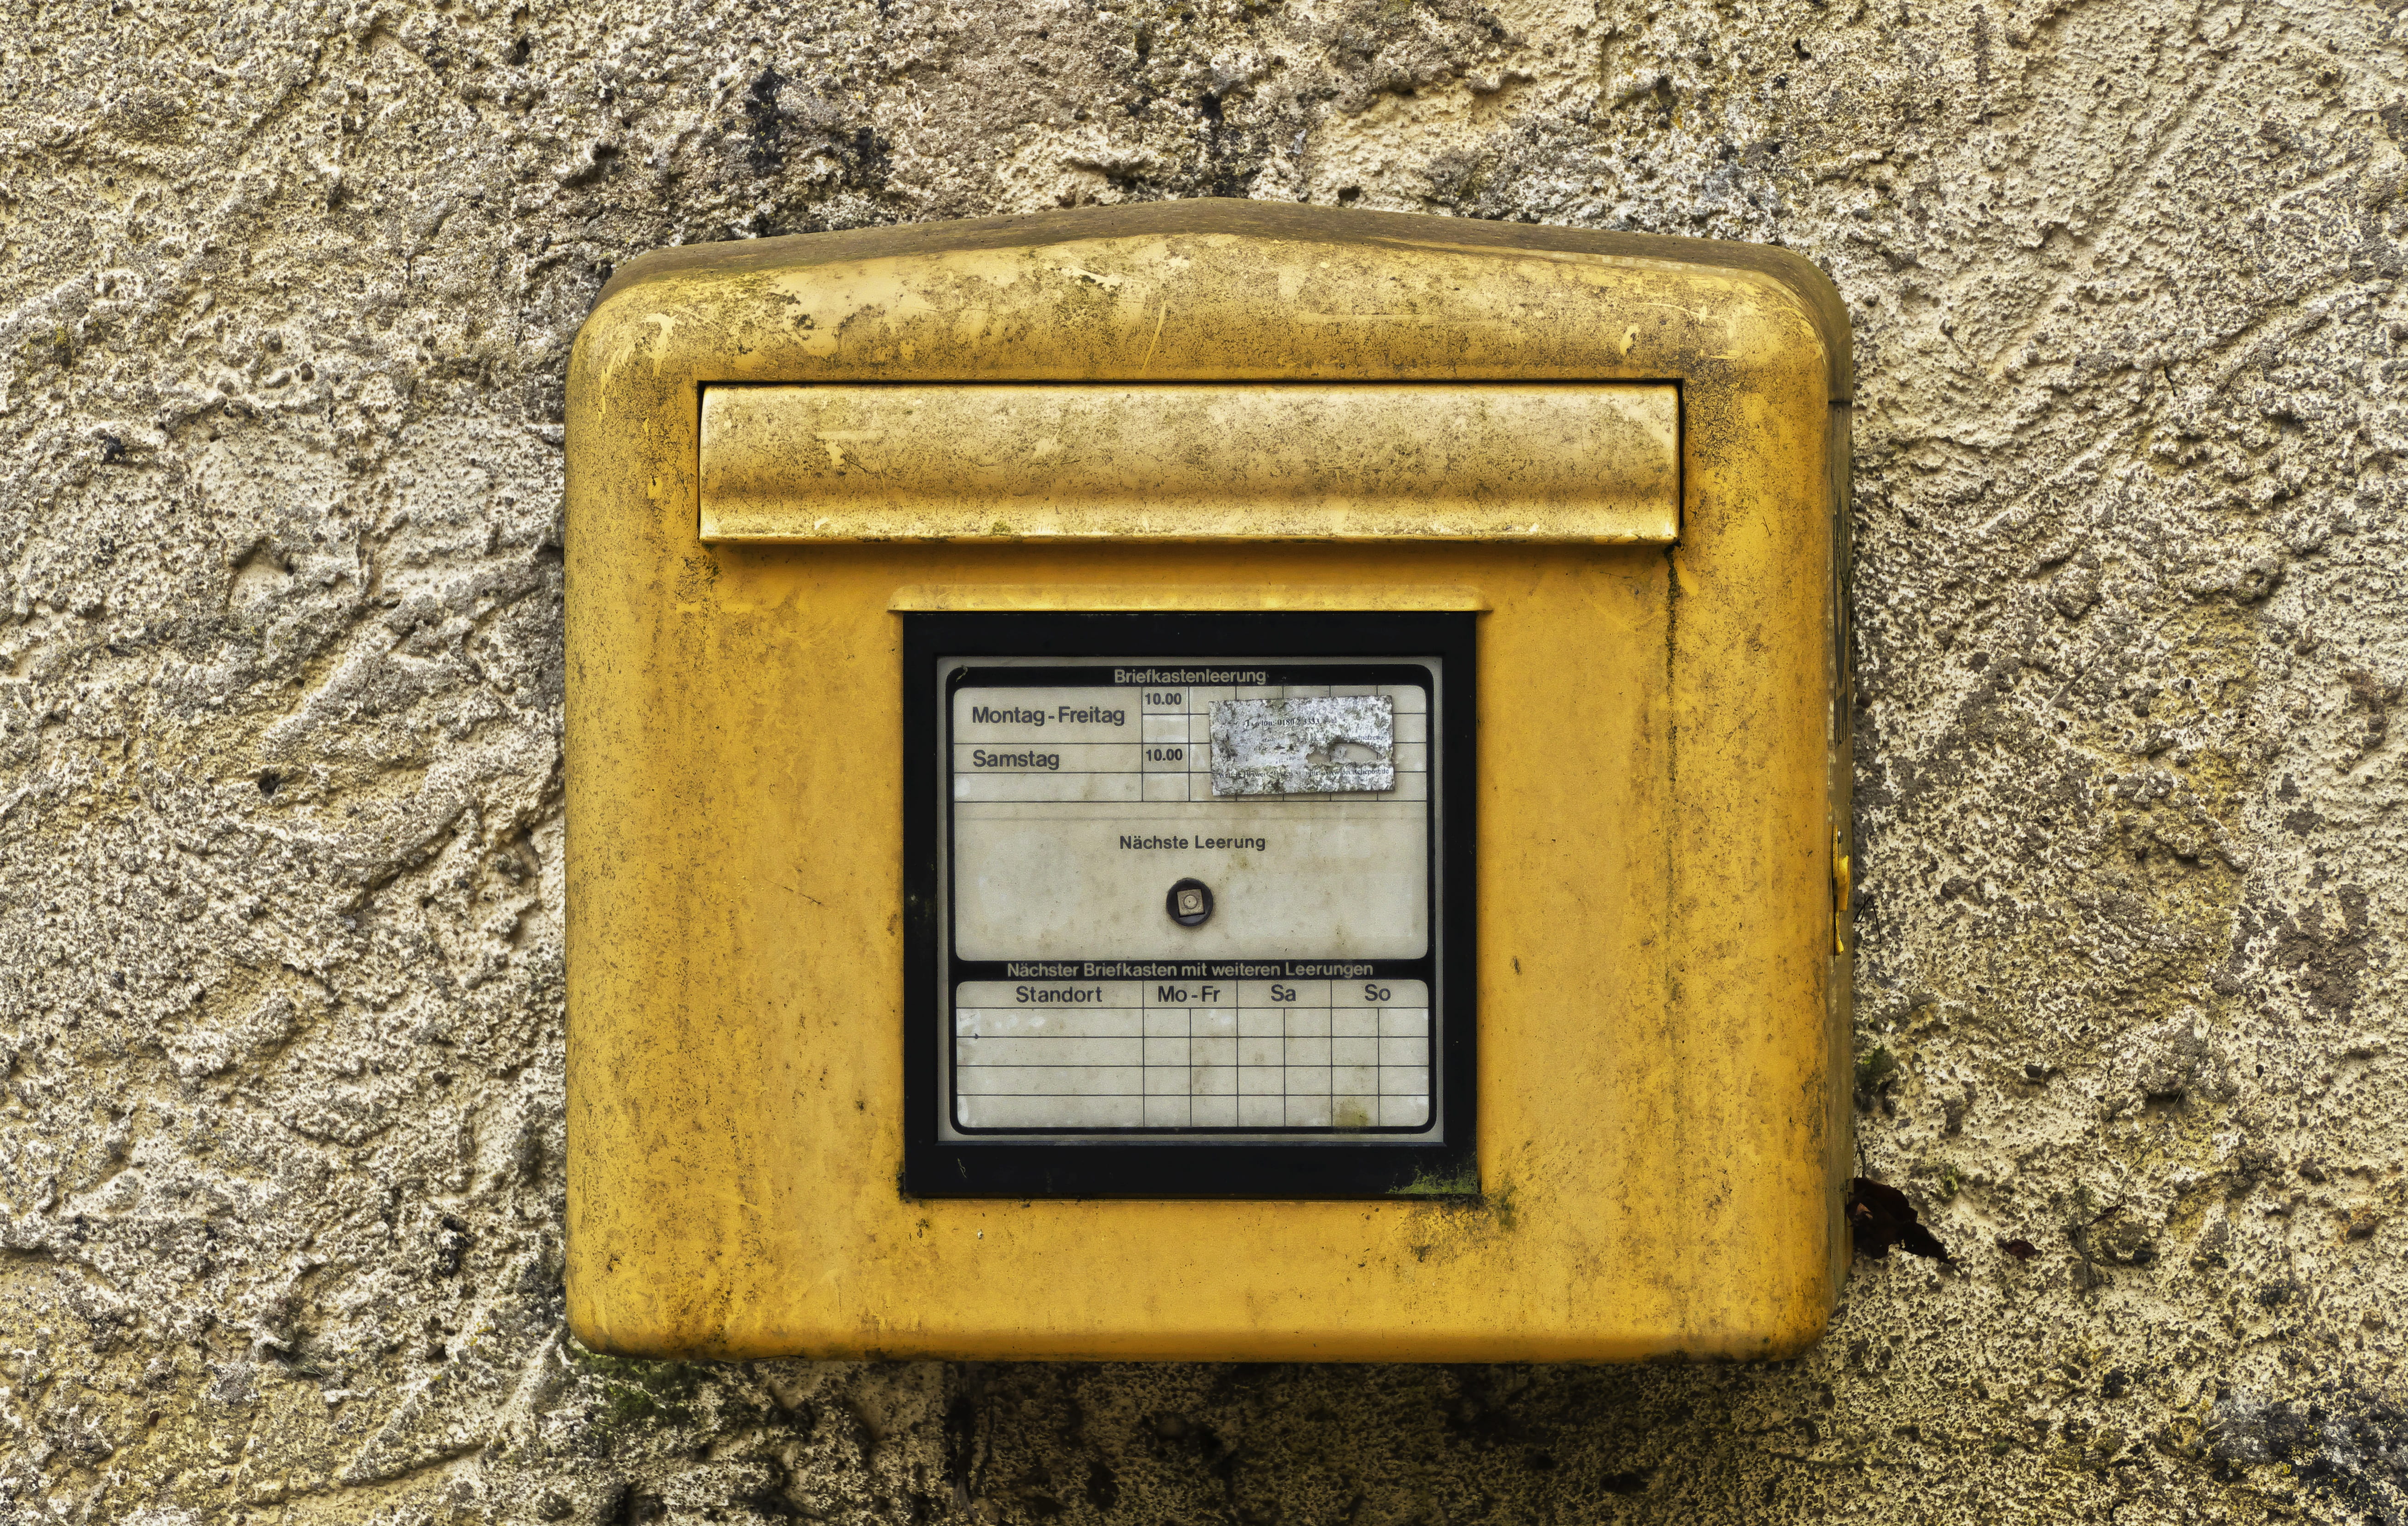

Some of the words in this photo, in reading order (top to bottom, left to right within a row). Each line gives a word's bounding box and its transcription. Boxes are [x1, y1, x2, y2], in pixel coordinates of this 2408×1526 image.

[1114, 669, 1266, 685] Briefkastenleerung
[1145, 692, 1182, 706] 10.00
[973, 749, 1060, 770] Samstag
[1146, 748, 1183, 762] 10.00
[1120, 835, 1189, 850] Nächste
[1195, 835, 1266, 852] Leerung
[1007, 962, 1079, 977] Nächster
[1084, 962, 1177, 977] Briefkasten
[1181, 962, 1207, 976] mit
[1211, 962, 1280, 976] weiteren
[1285, 962, 1373, 981] Leerungen
[1016, 985, 1103, 1003] Standort
[1271, 985, 1296, 1003] Sa
[1364, 985, 1391, 1002] So
